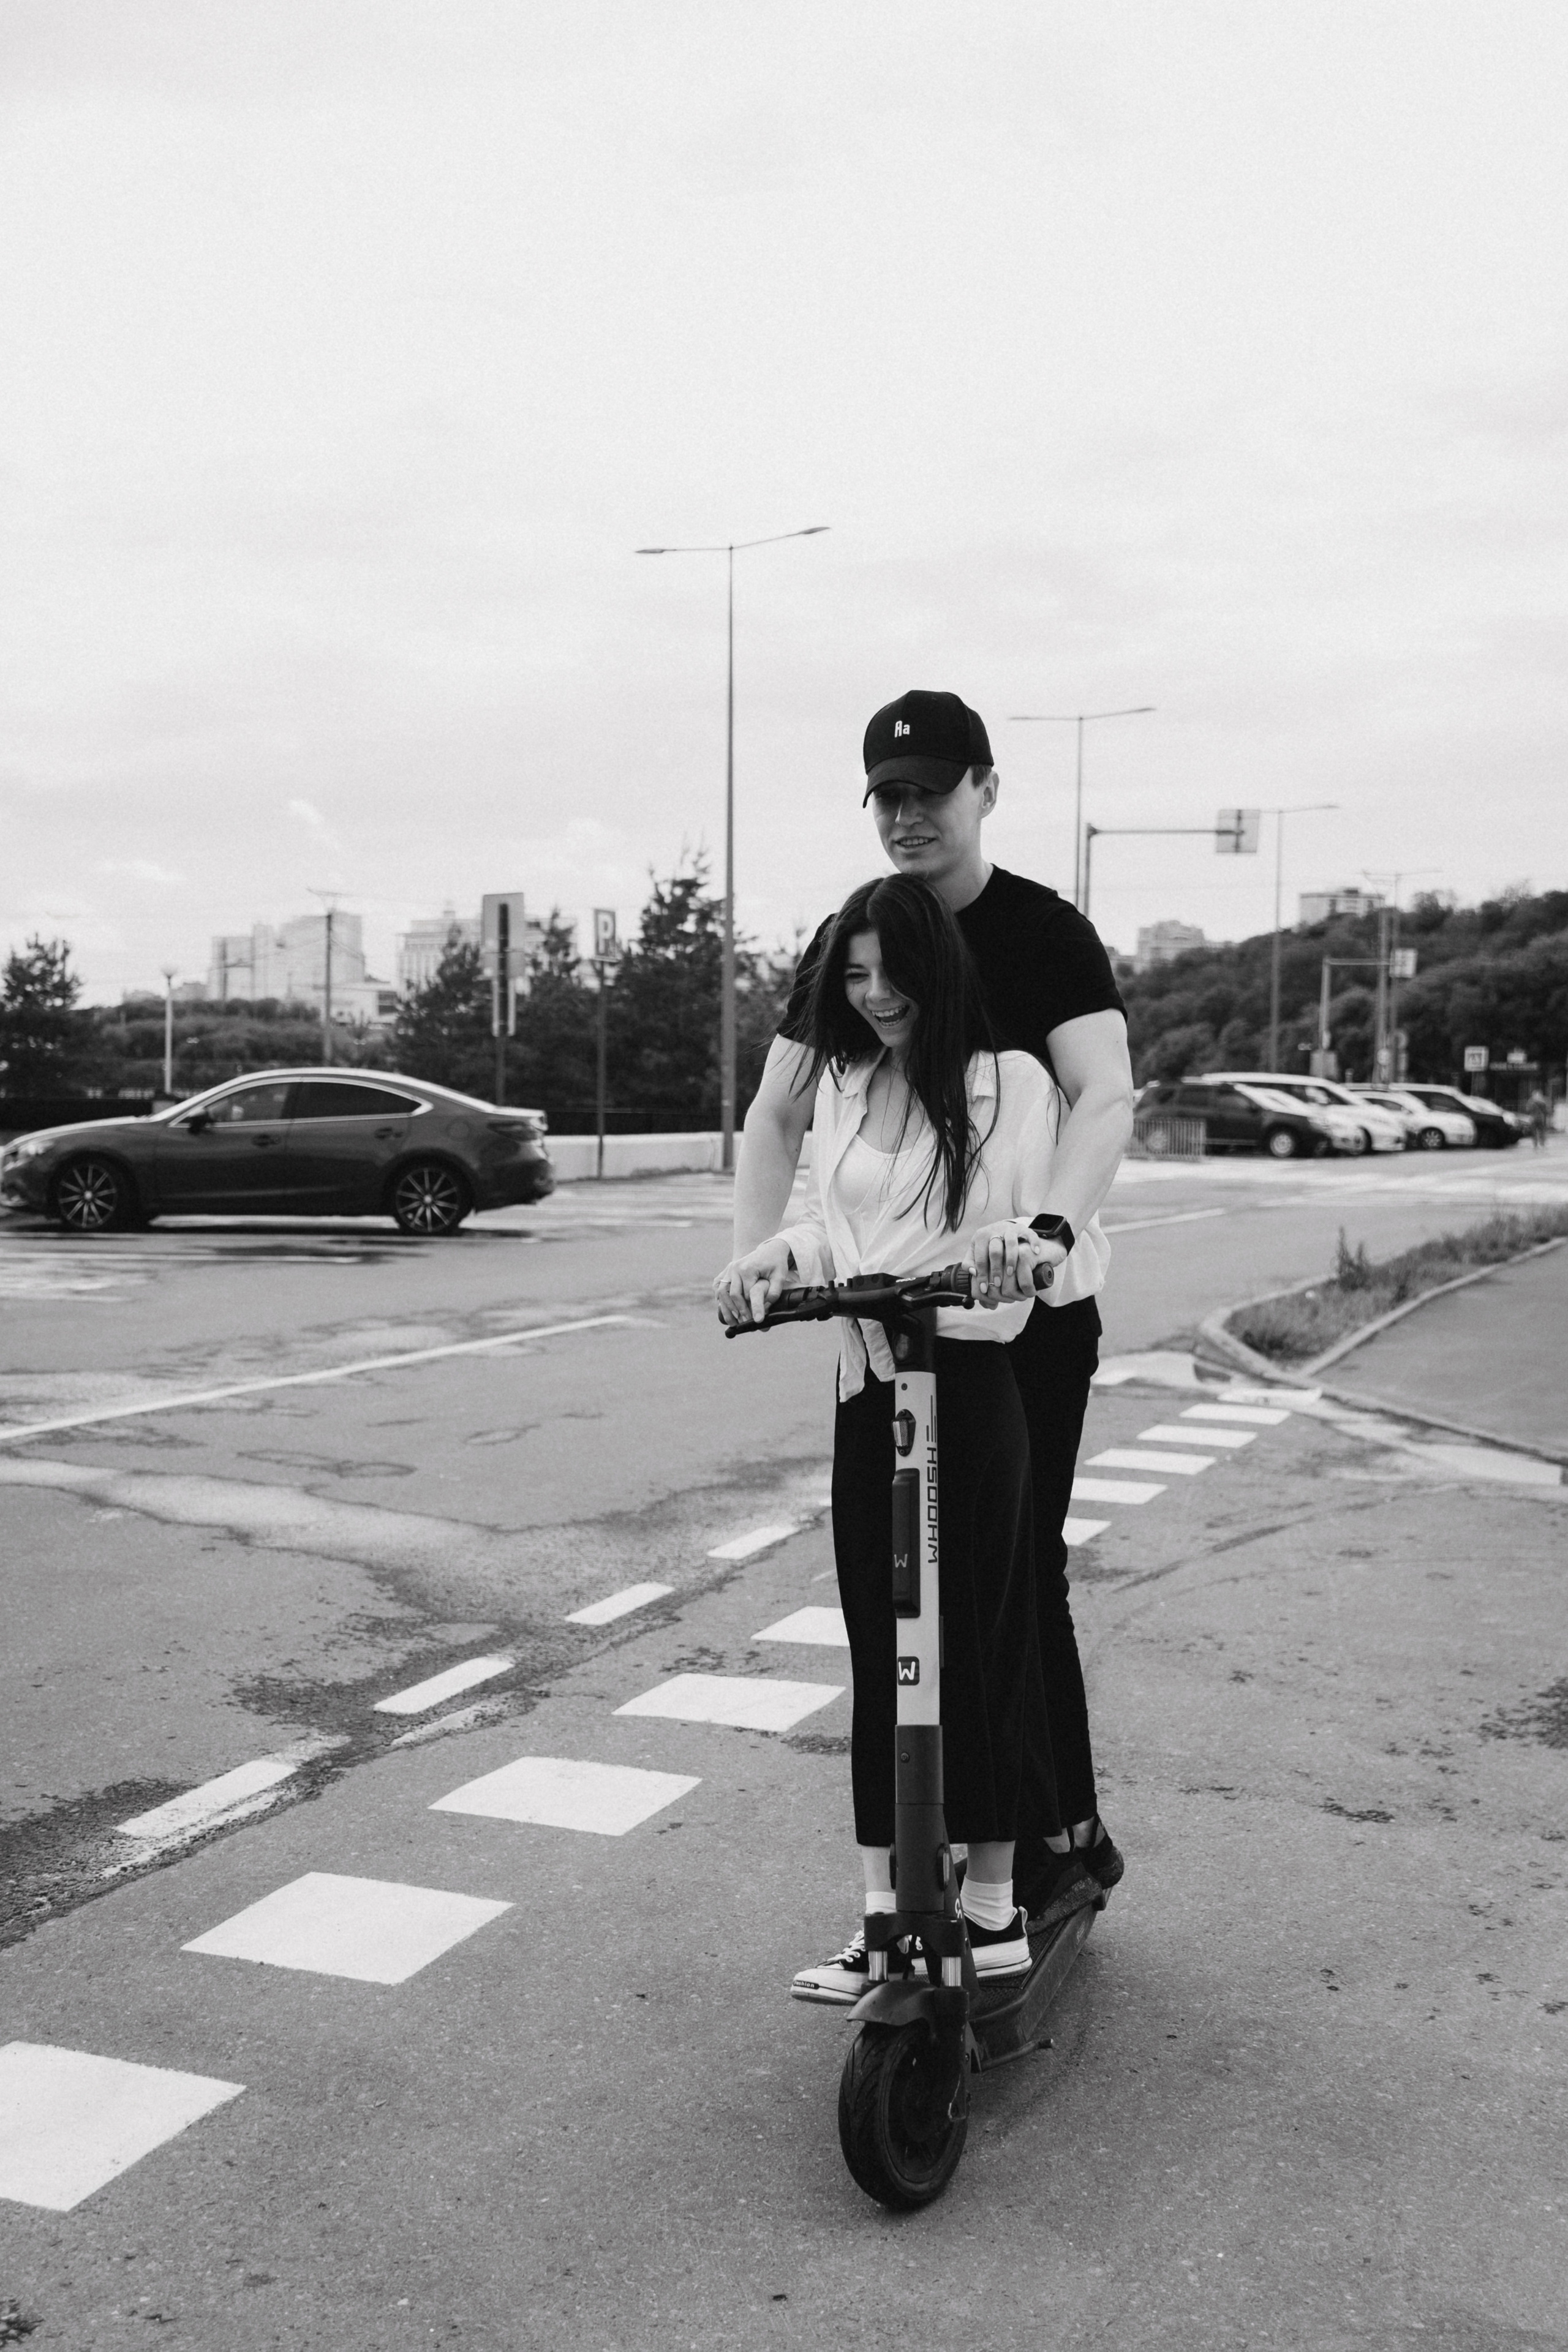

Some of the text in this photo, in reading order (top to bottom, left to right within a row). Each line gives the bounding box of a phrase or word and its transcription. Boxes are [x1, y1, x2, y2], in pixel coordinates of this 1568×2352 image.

[894, 720, 910, 737] Aa
[598, 914, 613, 954] P
[927, 1447, 937, 1563] WHOOSH
[894, 1554, 908, 1568] W
[899, 1661, 916, 1680] W
